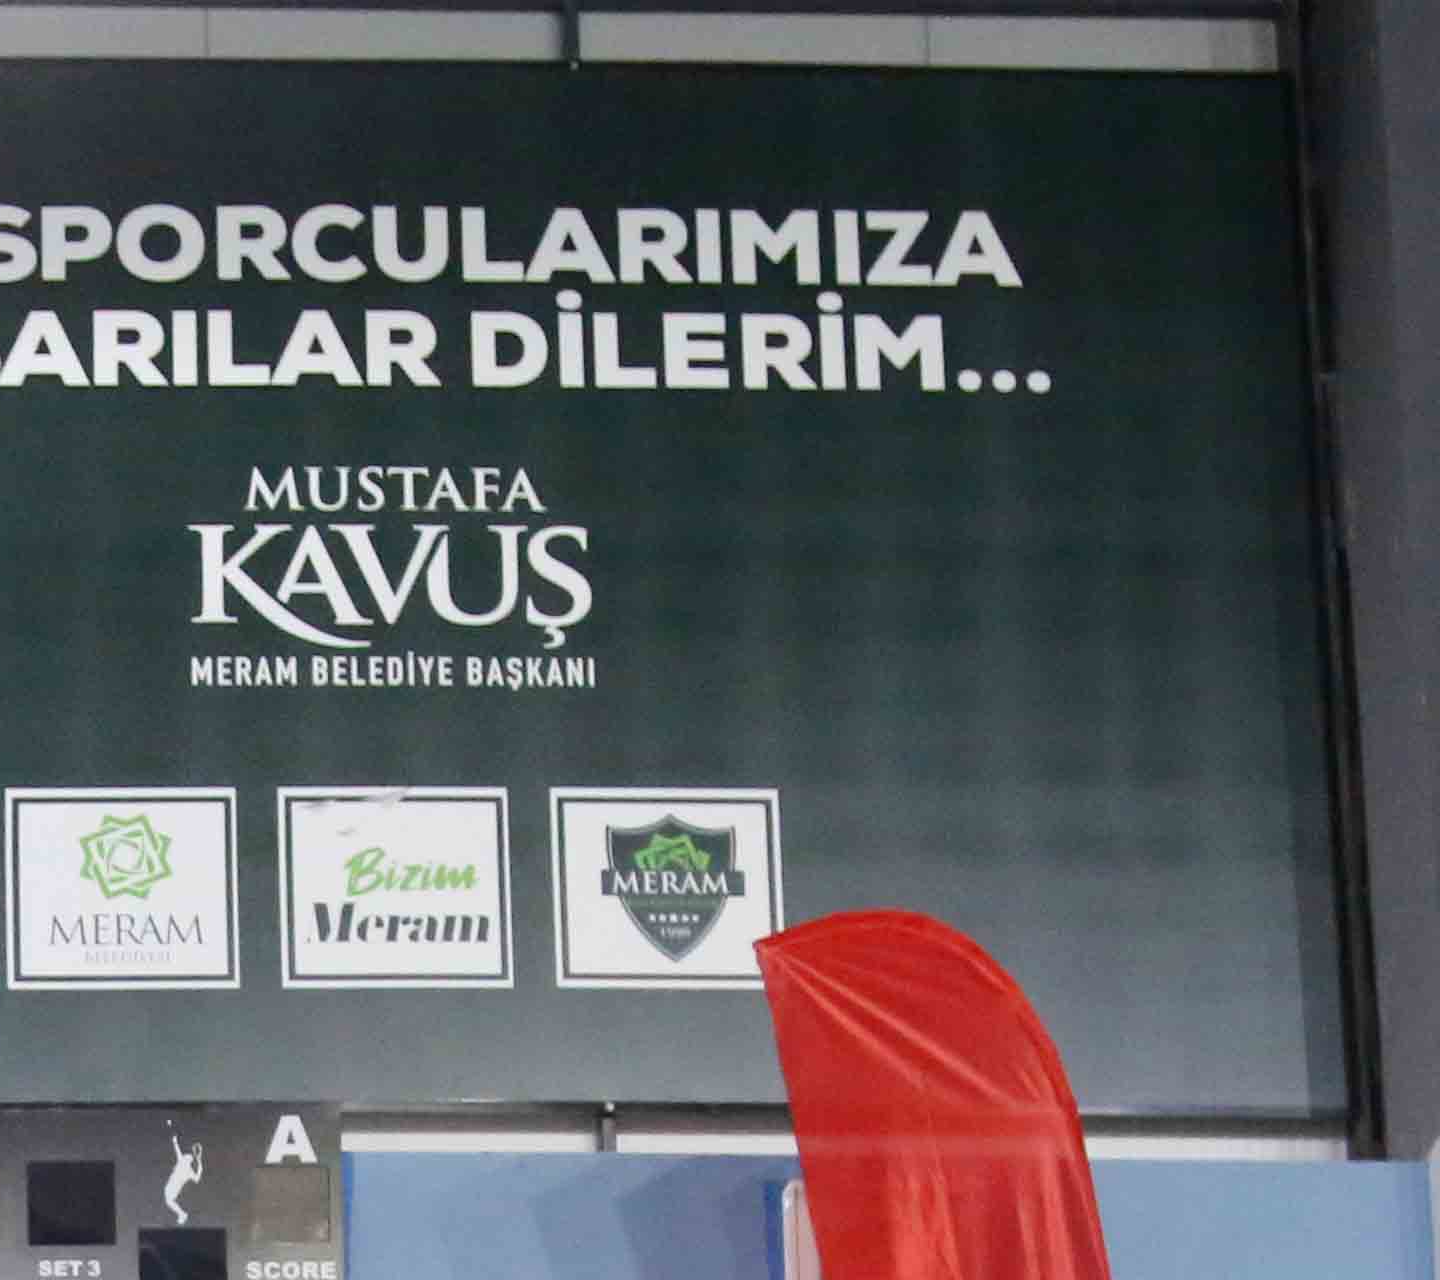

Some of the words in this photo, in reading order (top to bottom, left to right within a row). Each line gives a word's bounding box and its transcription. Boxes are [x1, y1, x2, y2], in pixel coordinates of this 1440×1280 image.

[470, 289, 1051, 394] DİLERİM...
[245, 464, 548, 514] MUSTAFA
[186, 522, 594, 649] KAVUŞ
[190, 655, 299, 688] MERAM
[310, 651, 455, 688] BELEDİYE
[466, 655, 597, 693] BAŞKANI
[344, 847, 479, 896] Bizim
[613, 870, 729, 895] MERAM
[48, 911, 203, 946] MERAM
[304, 901, 490, 943] Meram
[265, 1115, 318, 1164] A
[38, 1259, 81, 1279] SET
[85, 1259, 102, 1278] 3
